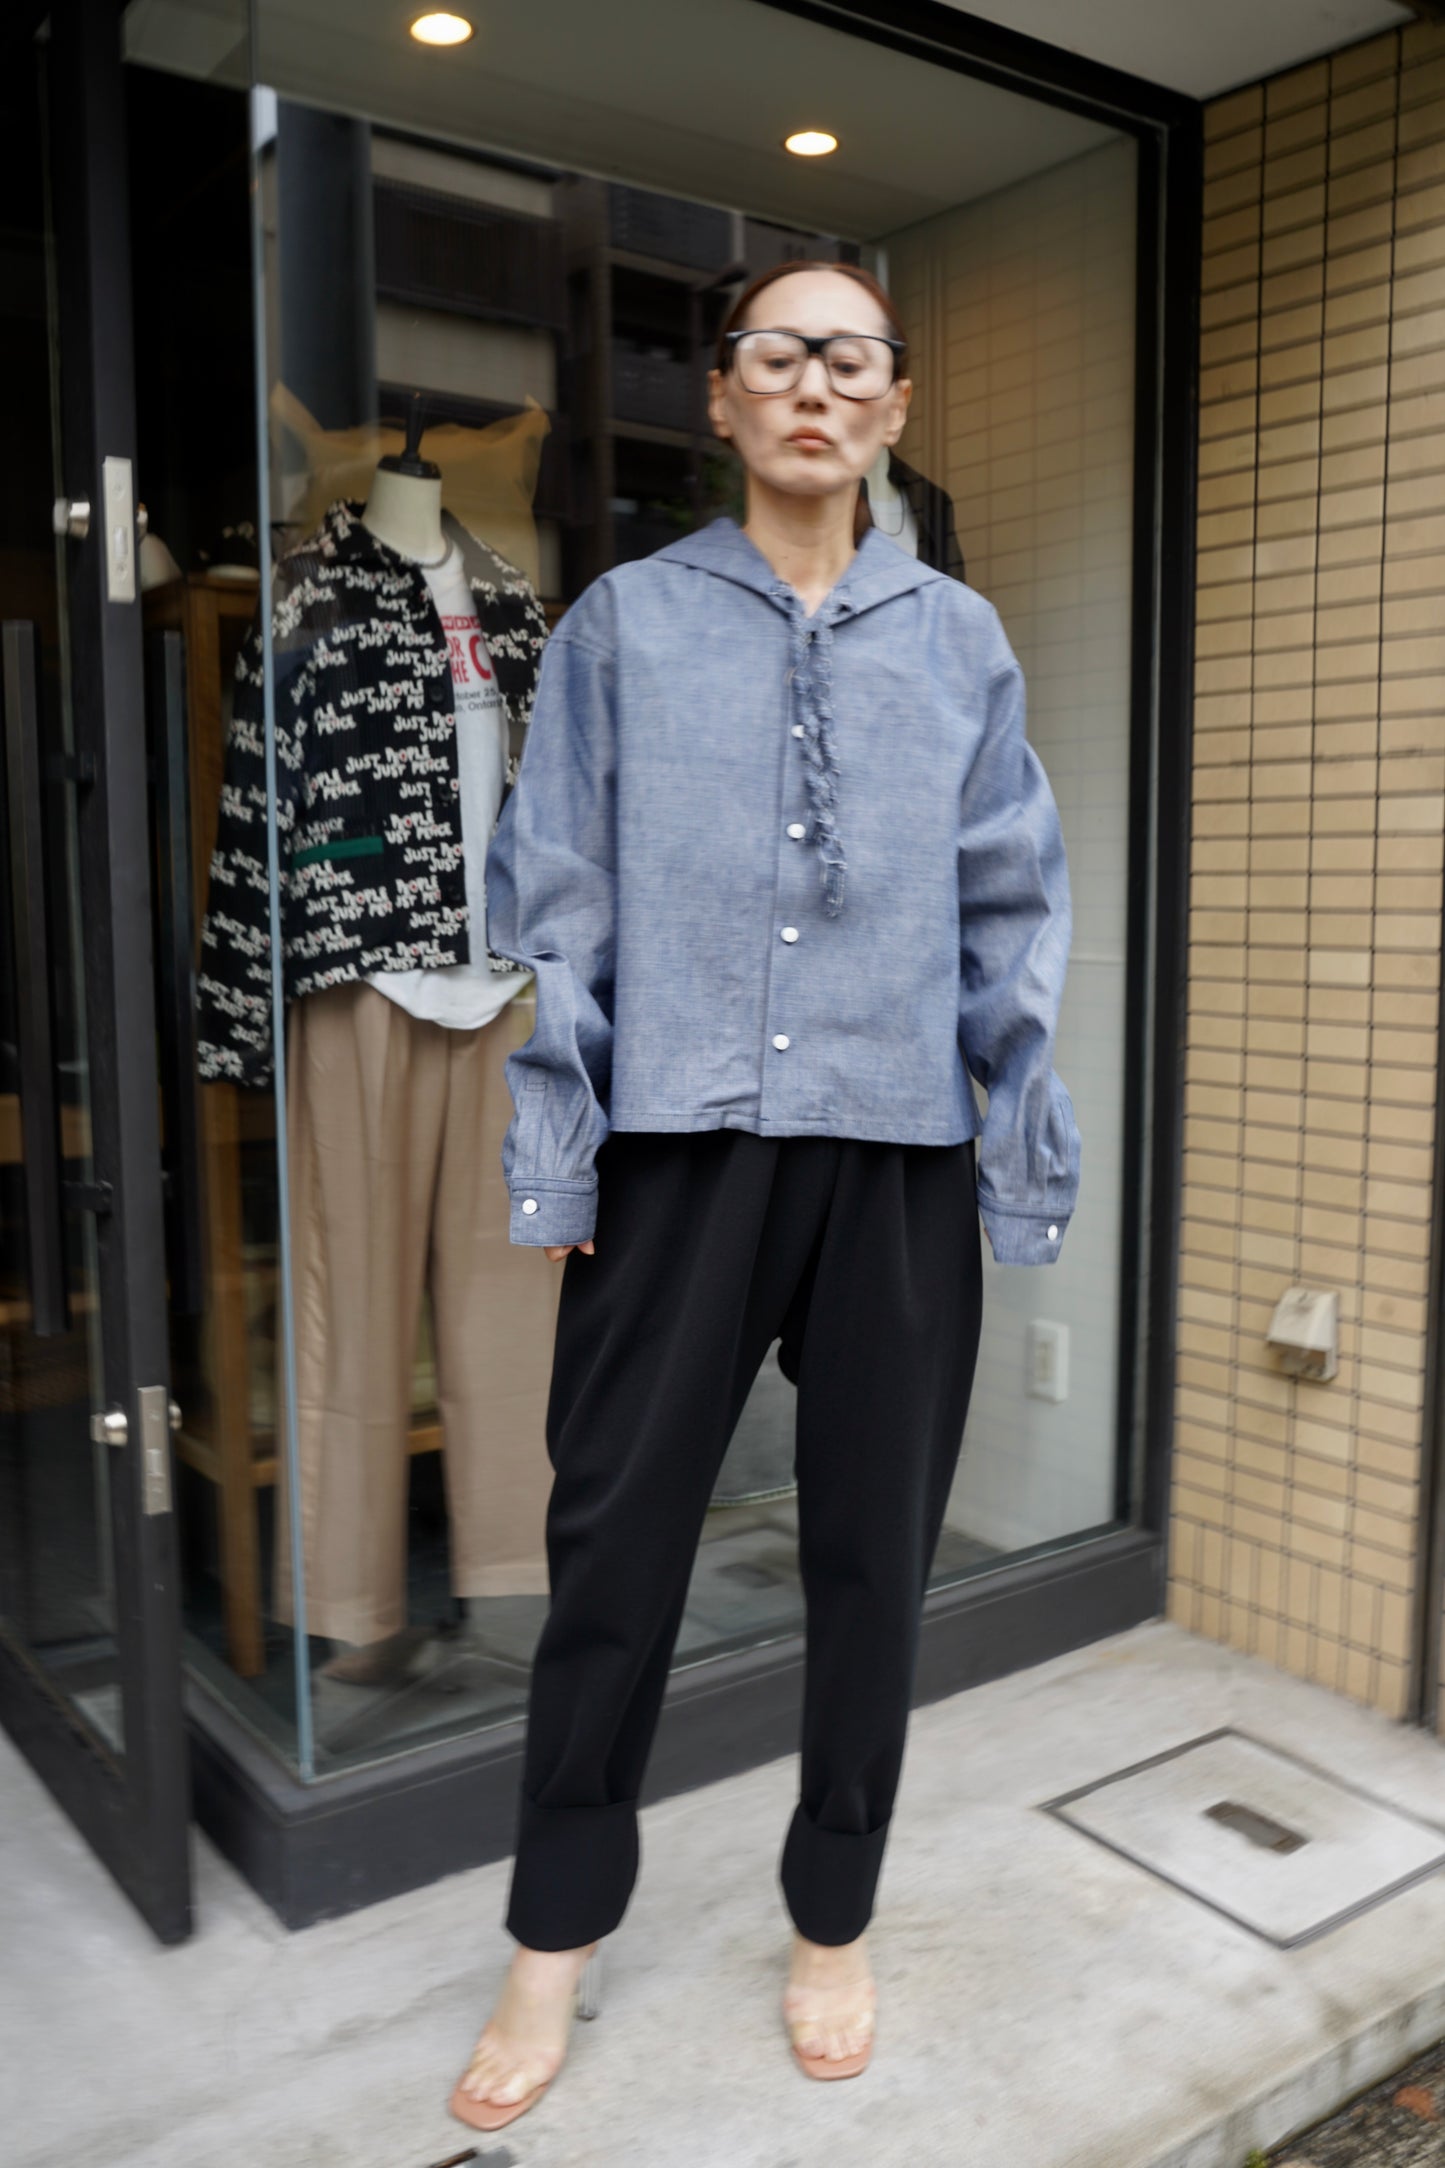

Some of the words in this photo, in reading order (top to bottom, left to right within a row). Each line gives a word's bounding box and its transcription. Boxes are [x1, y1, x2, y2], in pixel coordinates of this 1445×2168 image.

[332, 623, 366, 645] JUST
[359, 632, 392, 650] JUST
[386, 650, 421, 667] JUST
[413, 662, 446, 678] JUST
[340, 686, 375, 709] JUST
[367, 697, 401, 714] JUST
[393, 715, 429, 733] JUST
[419, 728, 453, 742] JUST
[346, 753, 382, 775] JUST
[384, 744, 432, 763] PEOPLE
[372, 764, 407, 780] JUST
[404, 846, 438, 865] JUST
[429, 858, 460, 872] JUST
[306, 895, 339, 917] JUST
[330, 904, 365, 922] JUST
[409, 911, 441, 928] JUST
[432, 922, 462, 937] JUST
[383, 956, 418, 972] JUST
